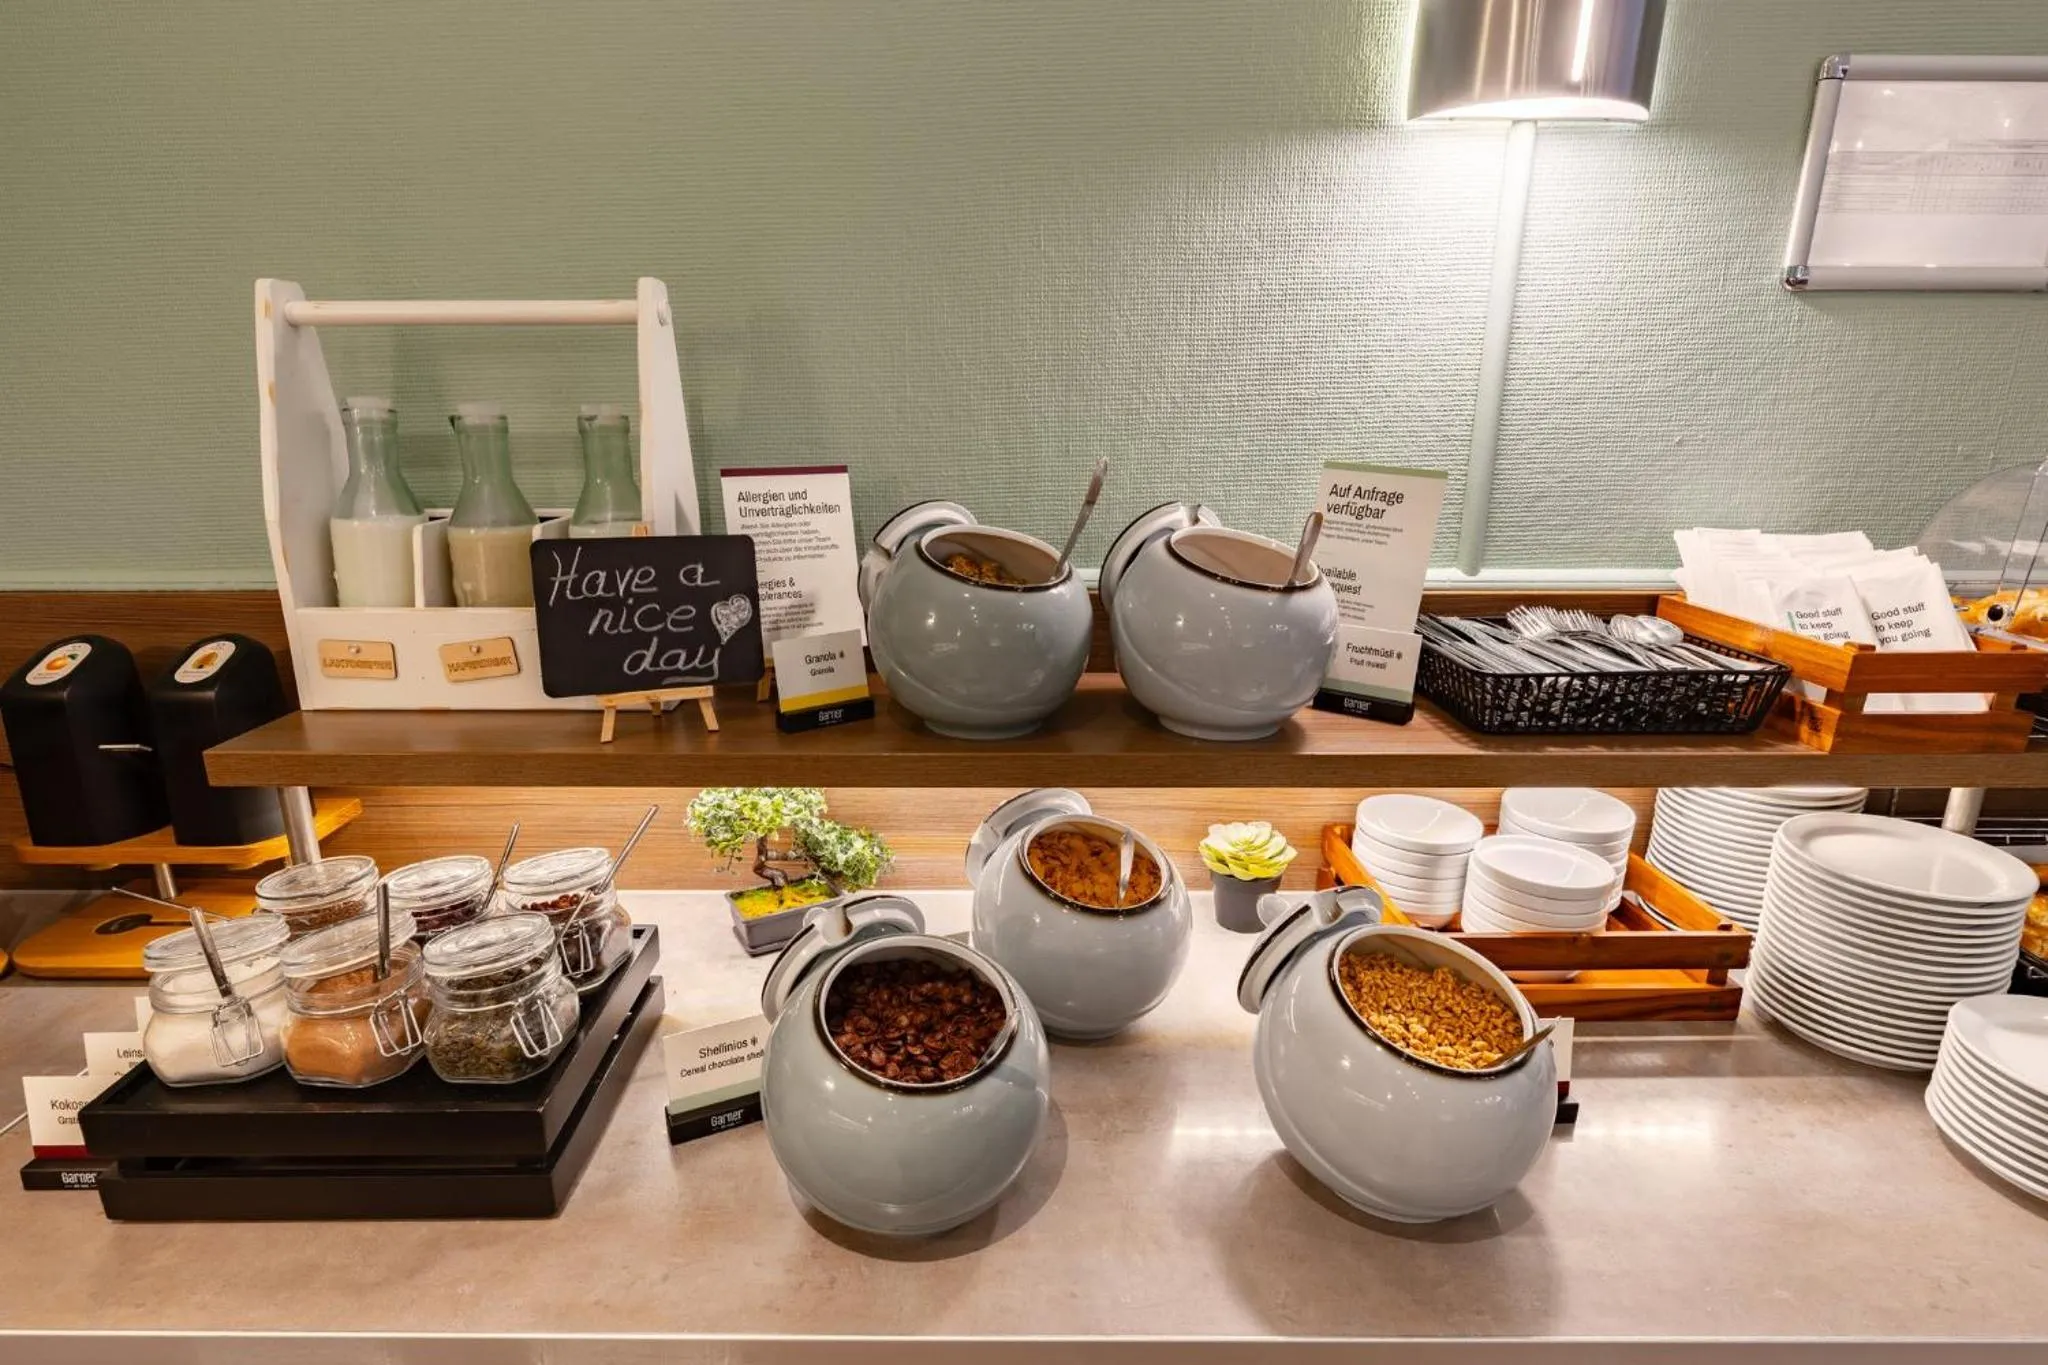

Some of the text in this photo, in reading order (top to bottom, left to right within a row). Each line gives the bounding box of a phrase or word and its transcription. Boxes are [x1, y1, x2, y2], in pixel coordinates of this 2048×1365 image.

[737, 488, 808, 504] Allergien und
[1328, 483, 1405, 507] Auf Anfrage
[1326, 500, 1386, 521] verfügbar
[549, 545, 721, 606] Have a
[1316, 565, 1357, 581] vailable
[758, 578, 787, 591] ergies
[1329, 582, 1362, 595] quest
[760, 590, 803, 602] olerances
[588, 597, 697, 636] nice
[1795, 607, 1843, 620] Good stuff
[1871, 601, 1926, 621] Good stuff
[1810, 620, 1833, 631] keep
[1873, 618, 1914, 633] to keep
[1878, 628, 1932, 647] you going
[622, 635, 721, 686] day
[804, 651, 837, 665] Granola
[116, 1047, 146, 1059] Leins
[698, 1039, 749, 1059] Shellinios
[680, 1064, 707, 1078] Cereal
[708, 1056, 745, 1071] chocolate
[51, 1099, 88, 1111] Kokos
[710, 1108, 745, 1127] Garner
[61, 1171, 97, 1184] Garner
